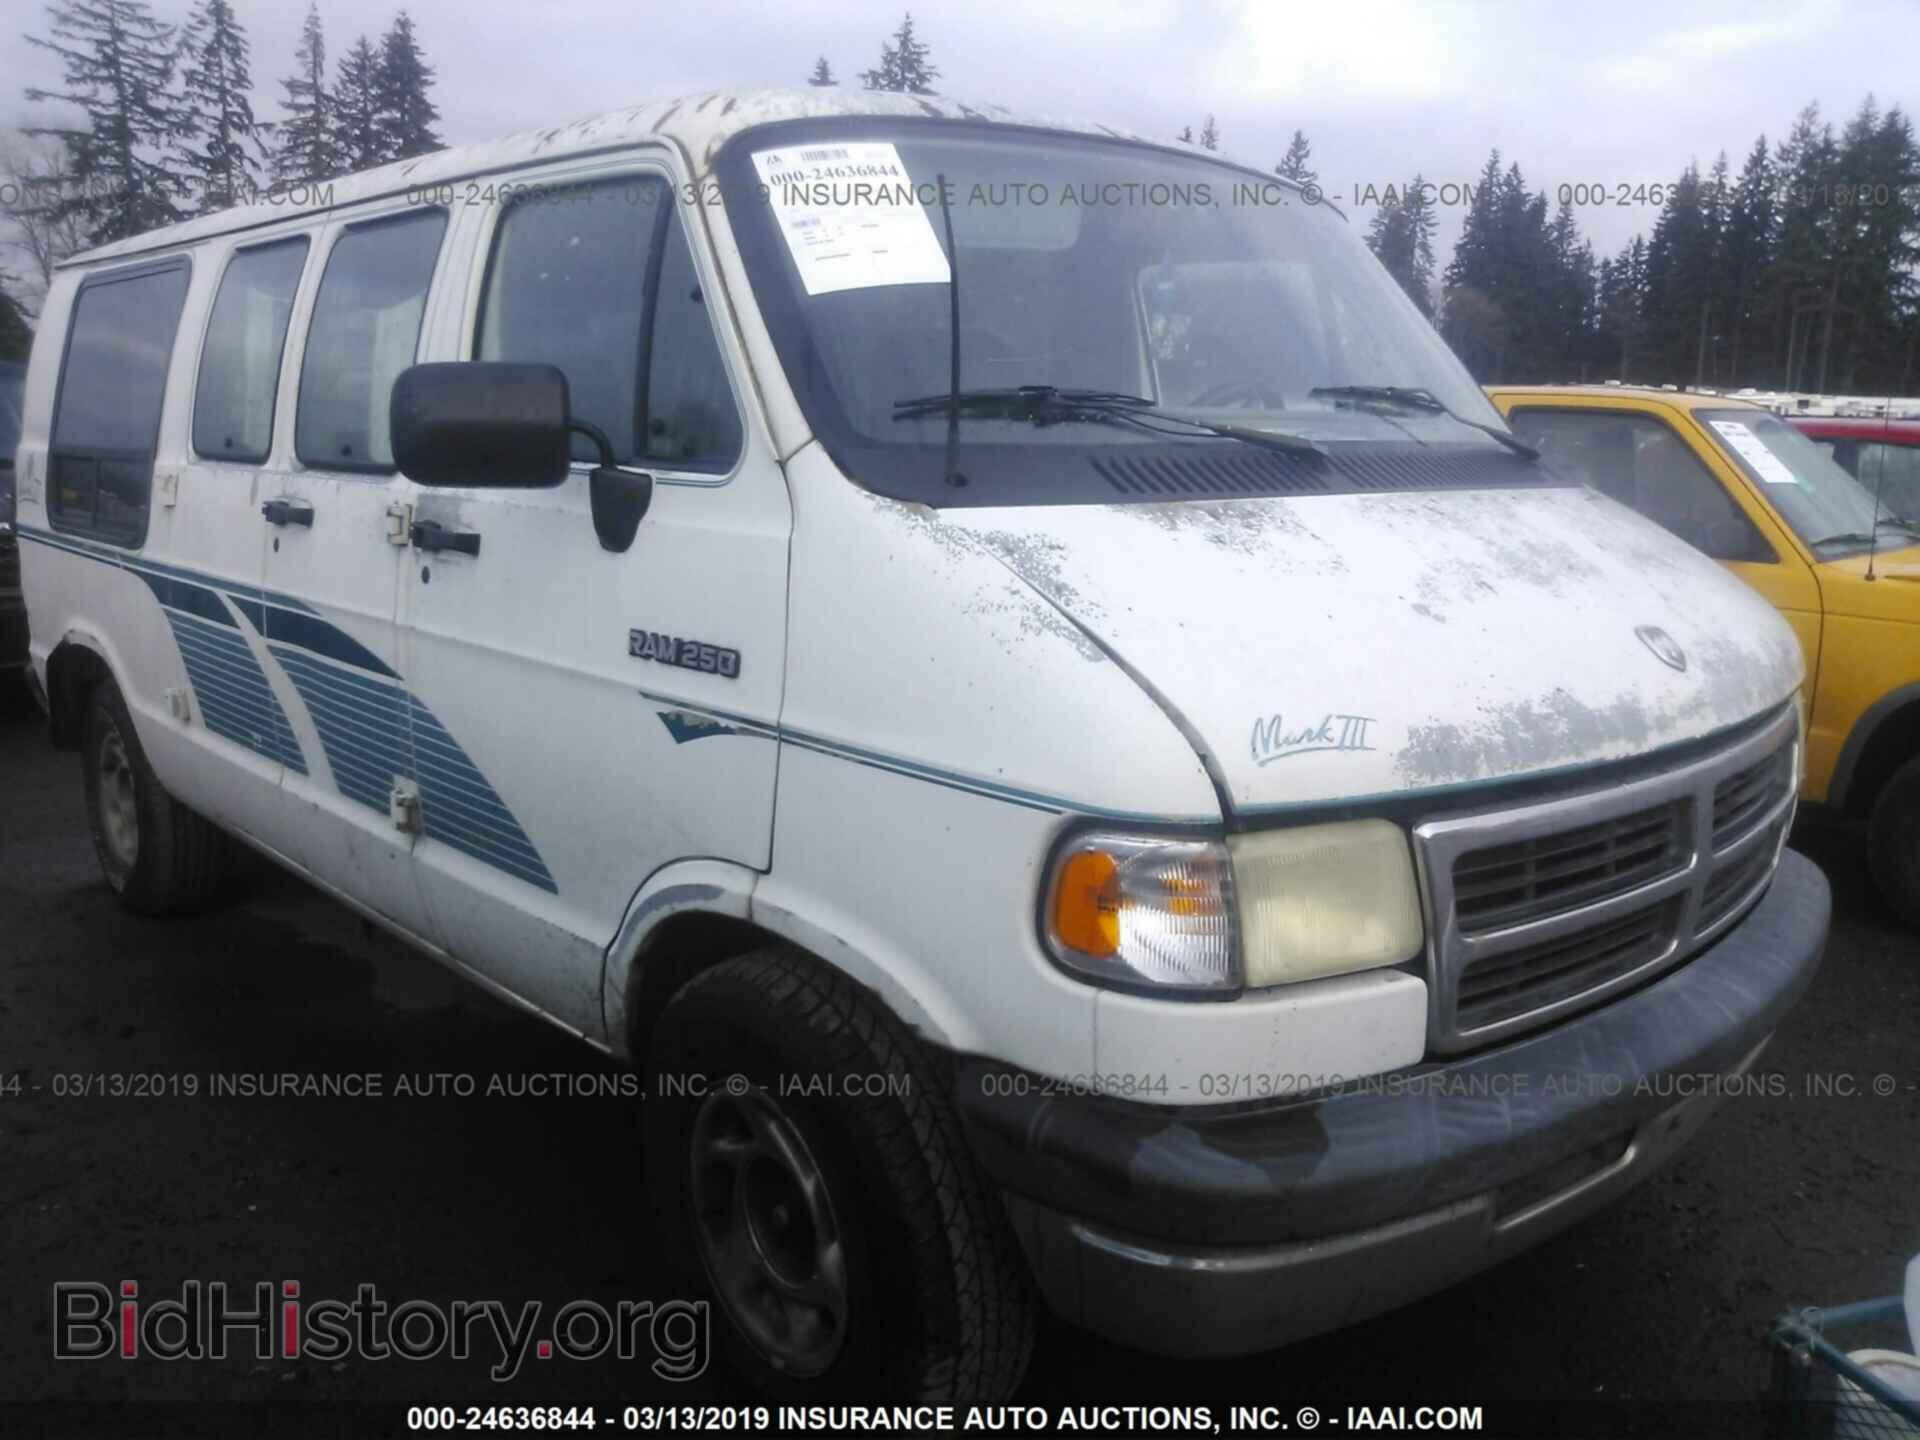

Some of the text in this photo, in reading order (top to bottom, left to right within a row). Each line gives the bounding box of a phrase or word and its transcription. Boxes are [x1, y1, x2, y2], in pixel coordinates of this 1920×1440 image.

[770, 164, 900, 186] 000-24636844
[629, 628, 741, 679] RAM 250
[1251, 714, 1377, 760] Mark III
